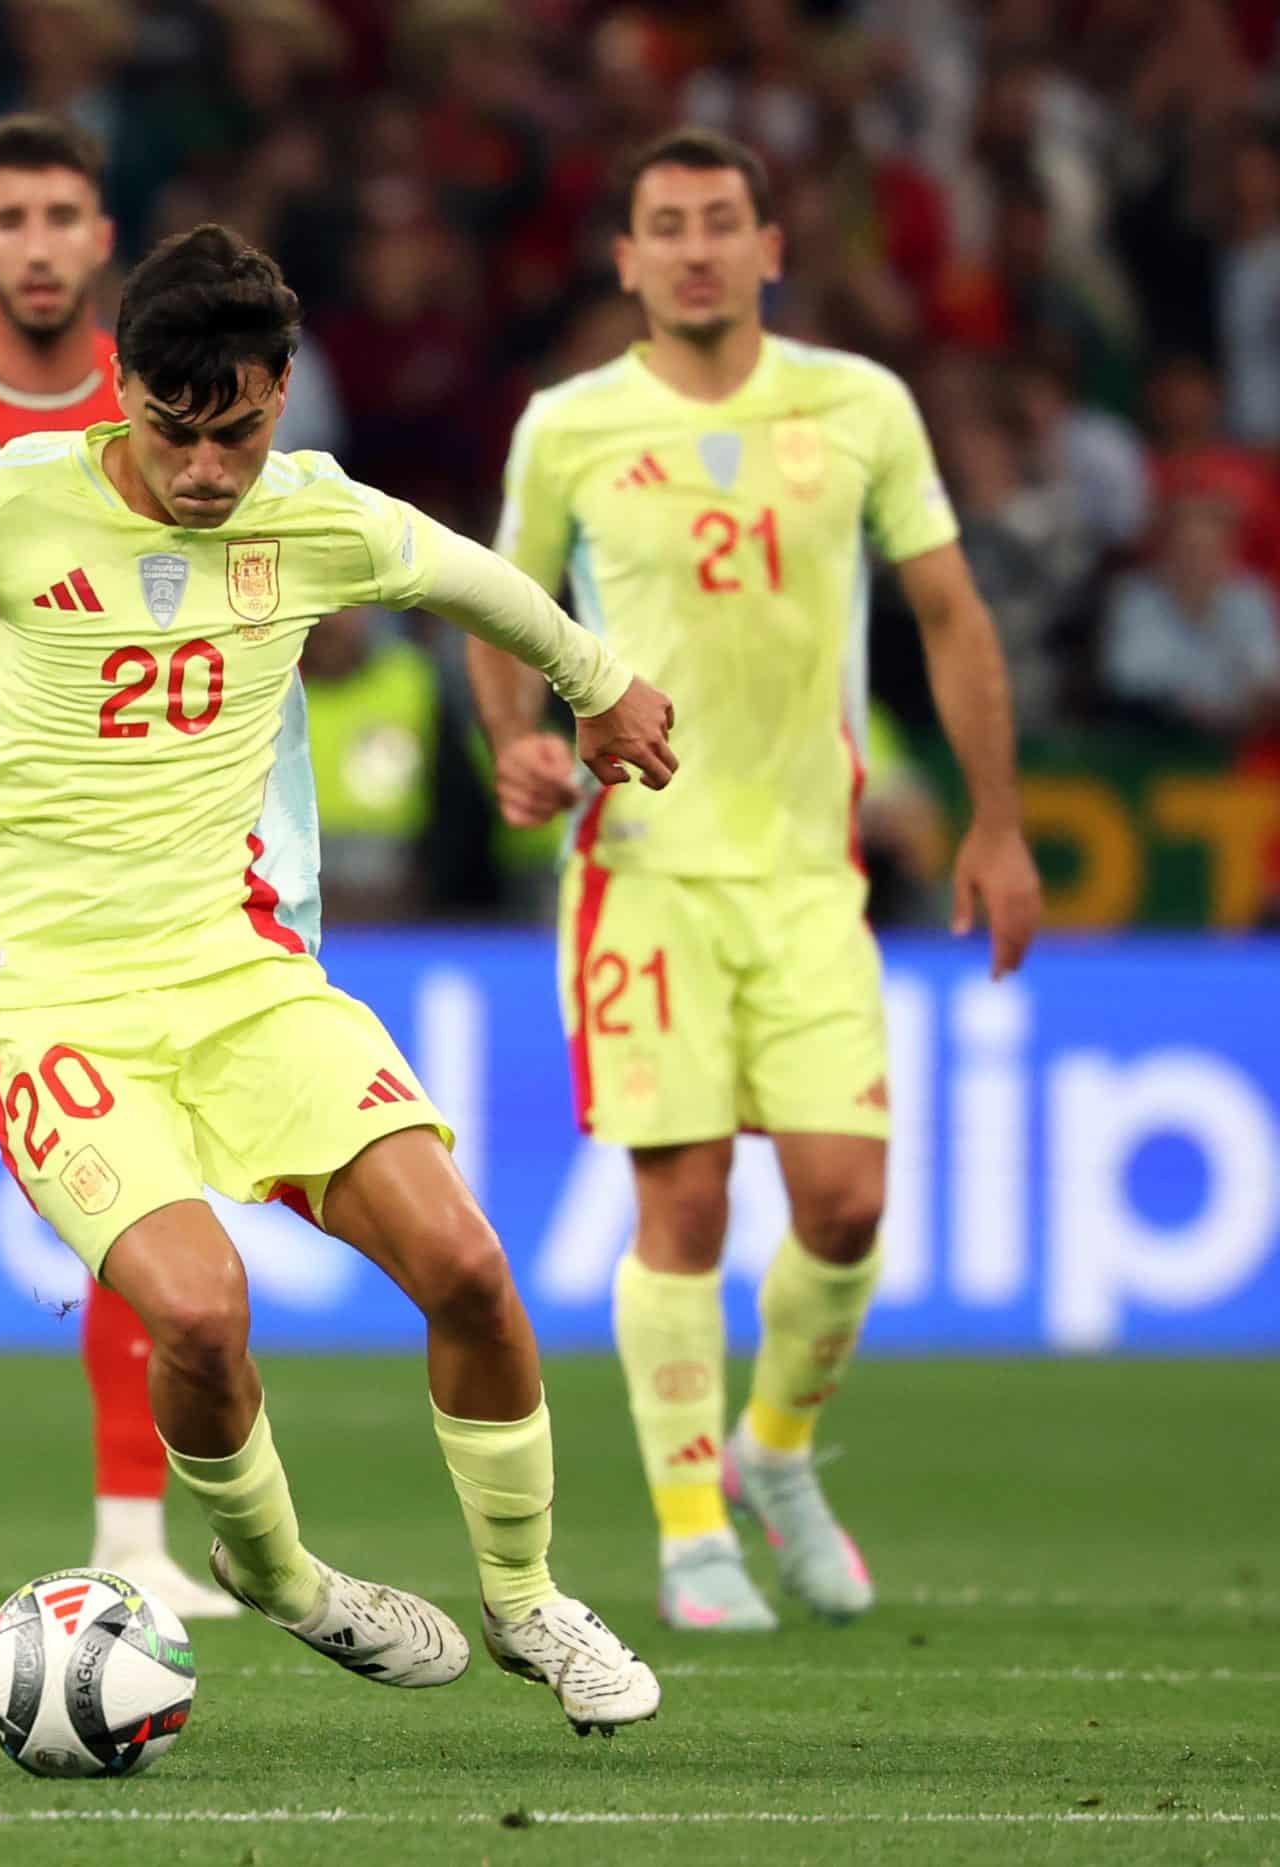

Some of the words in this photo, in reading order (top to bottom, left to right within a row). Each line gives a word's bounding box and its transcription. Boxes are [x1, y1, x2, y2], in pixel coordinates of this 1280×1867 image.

[690, 506, 783, 594] 21
[98, 639, 225, 739] 20
[588, 947, 672, 1037] 21
[5, 1044, 115, 1170] 20
